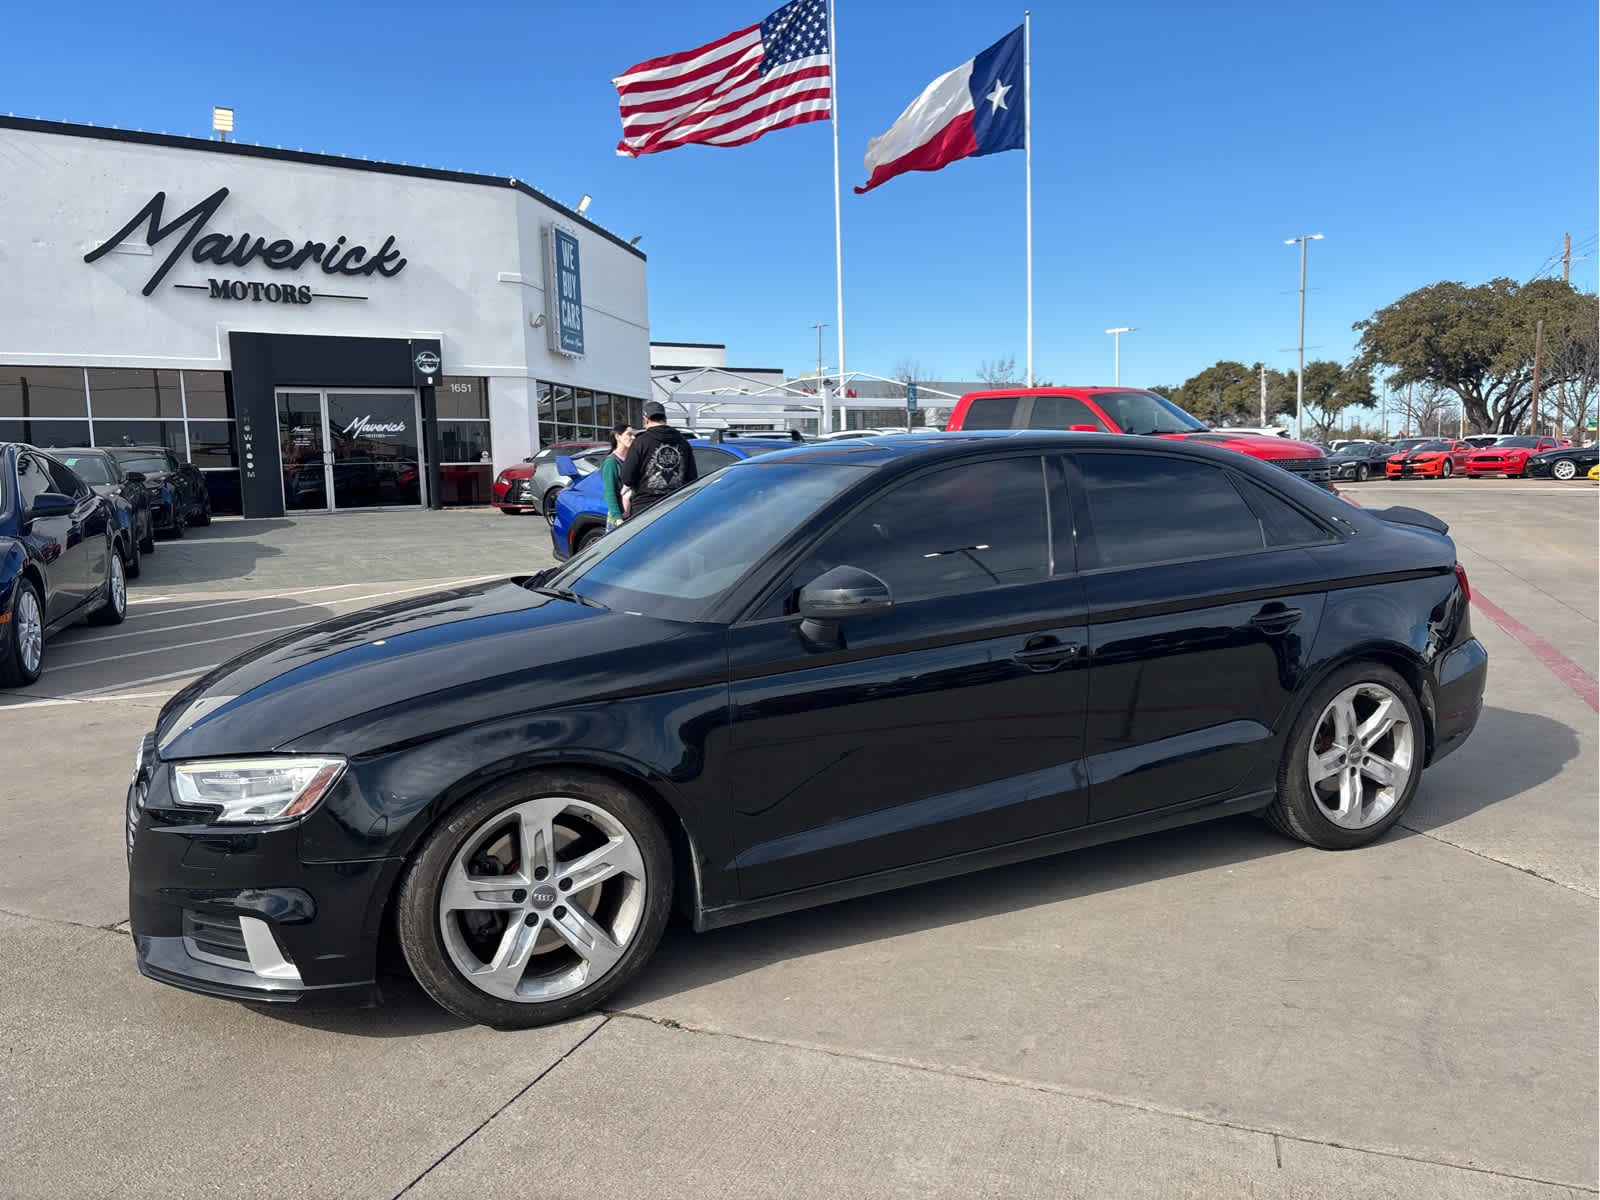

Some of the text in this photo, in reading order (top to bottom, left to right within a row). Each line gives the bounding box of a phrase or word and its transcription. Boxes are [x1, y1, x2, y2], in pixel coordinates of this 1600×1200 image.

[84, 187, 408, 297] Maverick
[561, 239, 575, 270] WE
[207, 278, 313, 305] MOTORS
[562, 270, 576, 300] BUY
[561, 300, 581, 330] CARS
[451, 383, 472, 393] 1651
[342, 414, 406, 440] Maverick
